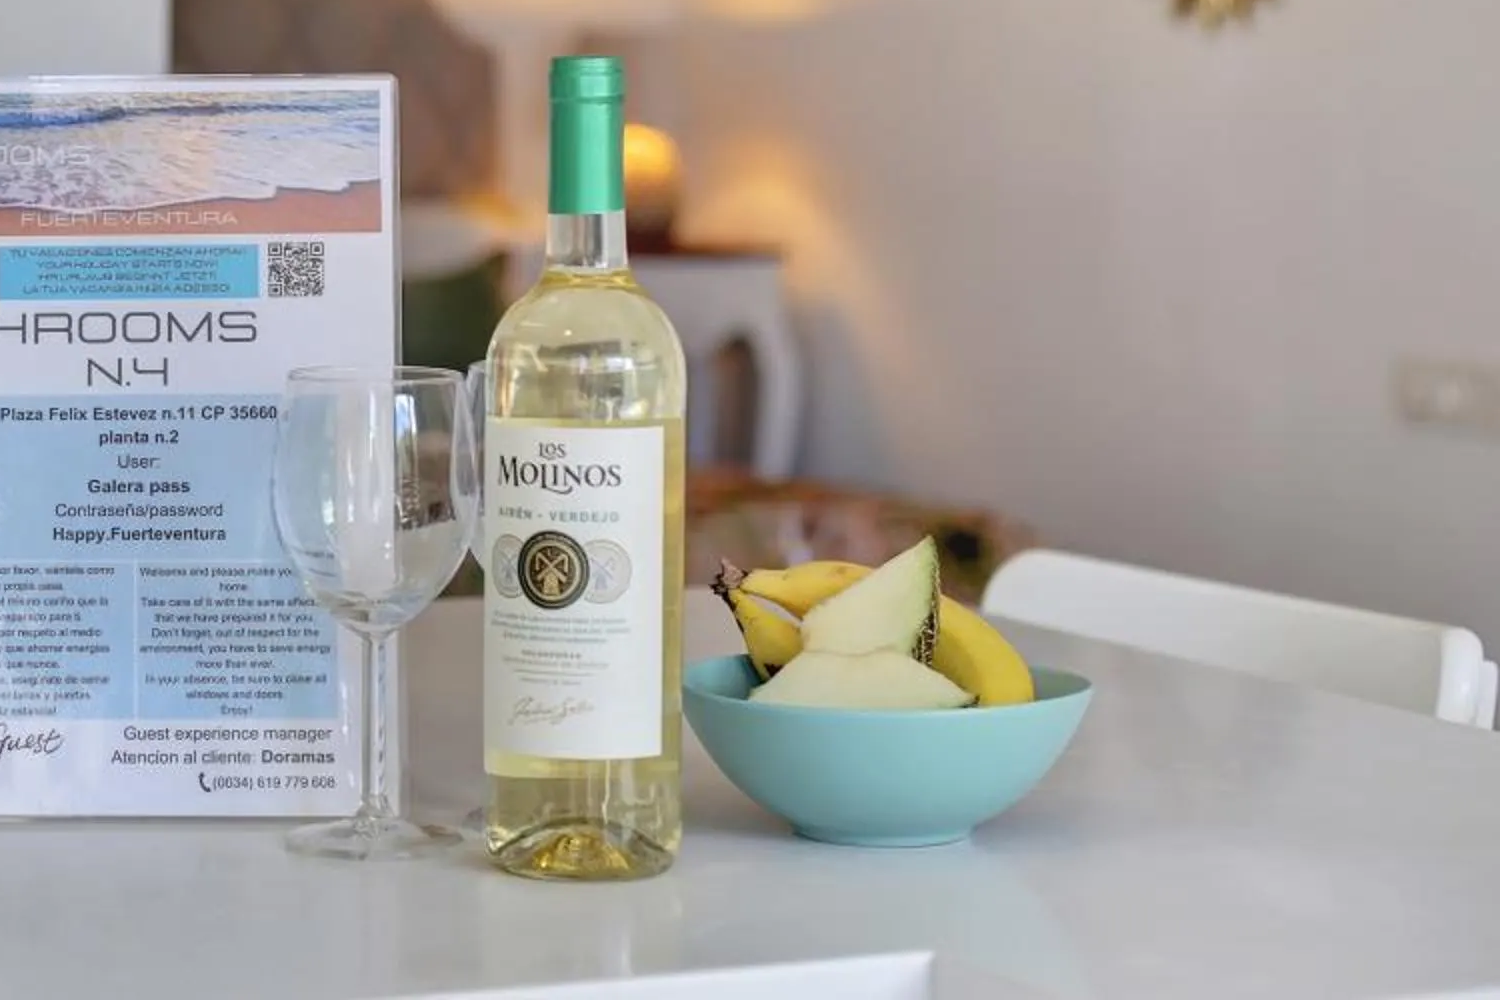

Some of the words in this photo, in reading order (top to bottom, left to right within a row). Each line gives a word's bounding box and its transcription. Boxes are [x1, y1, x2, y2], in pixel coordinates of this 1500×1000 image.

[20, 210, 239, 227] FUERTEVENTURA
[86, 358, 169, 387] N.4
[0, 407, 43, 421] Plaza
[49, 407, 88, 421] Felix
[93, 407, 157, 421] Estevez
[162, 406, 195, 420] n.11
[201, 406, 225, 419] CP
[230, 406, 277, 419] 35660
[99, 430, 149, 446] planta
[155, 430, 179, 444] n.2
[117, 455, 161, 468] User:
[87, 479, 144, 493] Galera
[150, 481, 190, 496] pass
[55, 503, 223, 521] Contraseña/password
[549, 510, 621, 523] VERDEJO
[52, 528, 227, 544] Happy.Fuerteventura
[123, 726, 169, 741] Guest
[175, 727, 259, 745] experience
[263, 728, 332, 745] manager
[183, 750, 197, 765] al
[261, 749, 335, 764] Doramas
[213, 776, 253, 791] (0034)
